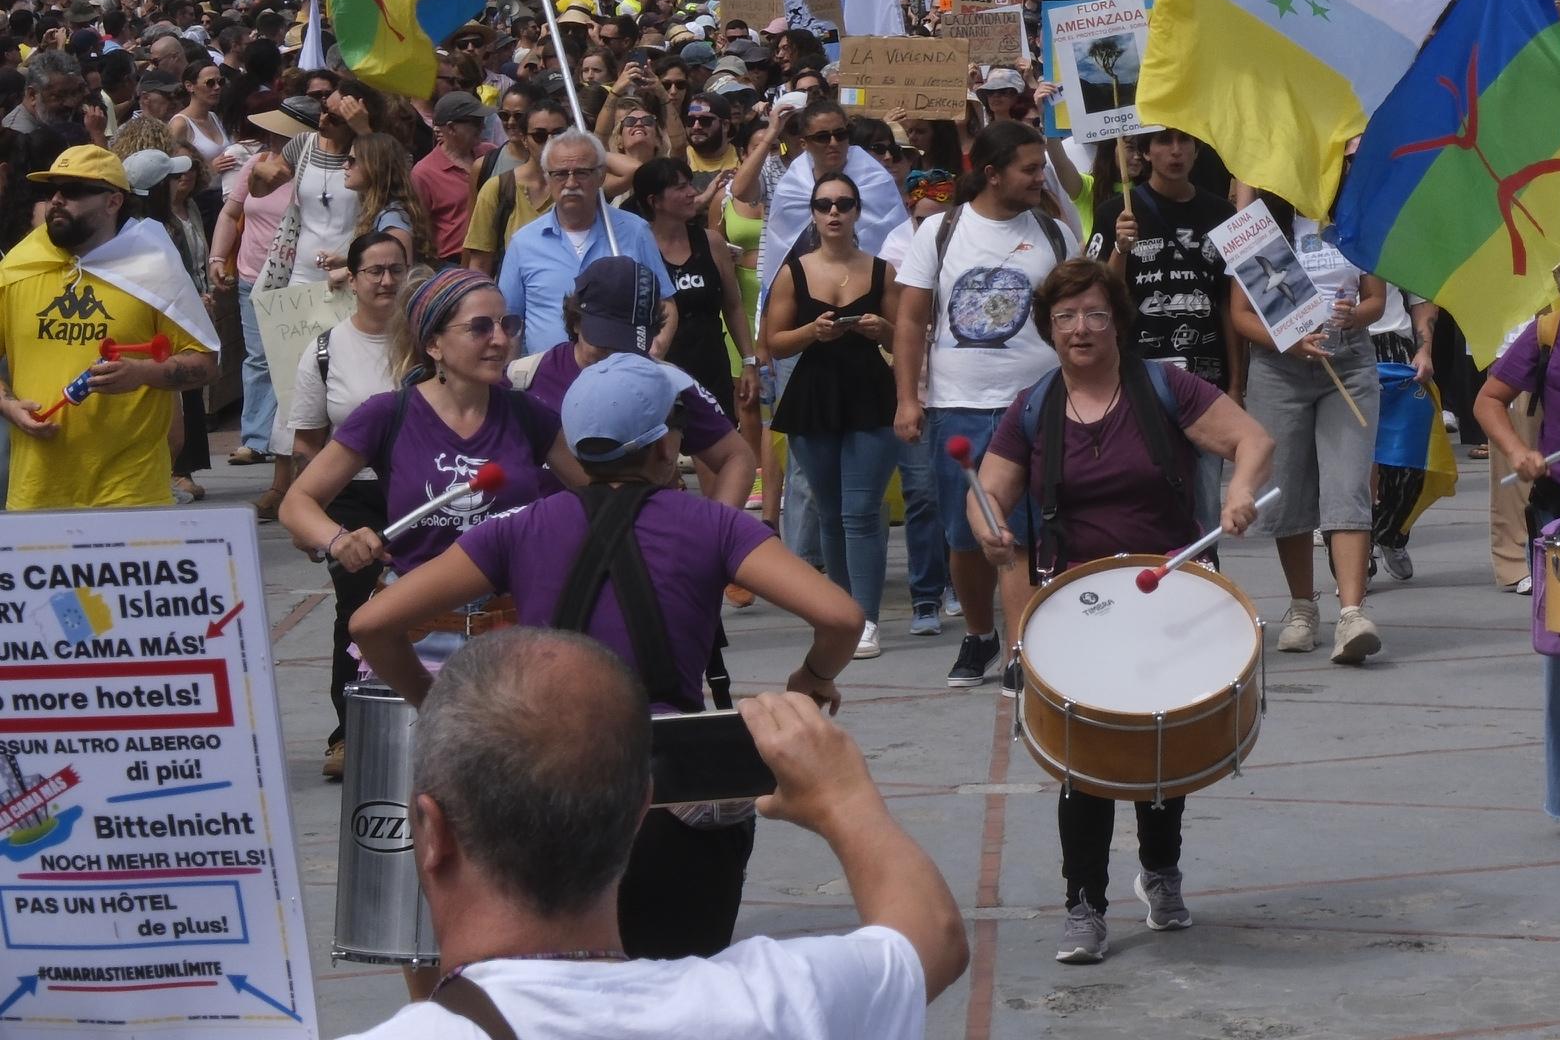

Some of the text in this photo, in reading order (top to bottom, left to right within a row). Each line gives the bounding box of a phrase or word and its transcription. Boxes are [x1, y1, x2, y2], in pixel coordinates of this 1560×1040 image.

[1077, 0, 1116, 14] FLORA
[1055, 9, 1144, 34] AMENAZADA
[850, 48, 957, 65] LA VIVIENDA
[914, 93, 964, 110] DERECHO
[1104, 113, 1133, 125] Drago
[1100, 127, 1120, 137] Gran
[1227, 212, 1252, 233] FAUNA
[1222, 216, 1274, 257] AMENAZADA
[37, 318, 108, 346] Kappa
[636, 325, 647, 351] GRAN
[23, 559, 199, 590] CANARIAS
[118, 587, 225, 620] Islands
[54, 637, 134, 659] CAMA
[140, 631, 206, 657] MÁS!
[12, 690, 88, 711] more
[96, 682, 201, 708] hotels!
[54, 735, 119, 753] ALTRO
[125, 733, 221, 751] ALBERGO
[127, 760, 147, 781] di
[94, 812, 254, 839] Bittelnicht
[41, 849, 266, 871] NOCH MEHR HOTELS!
[15, 892, 177, 914] PAS UN HÔTEL
[138, 916, 229, 939] de plus!
